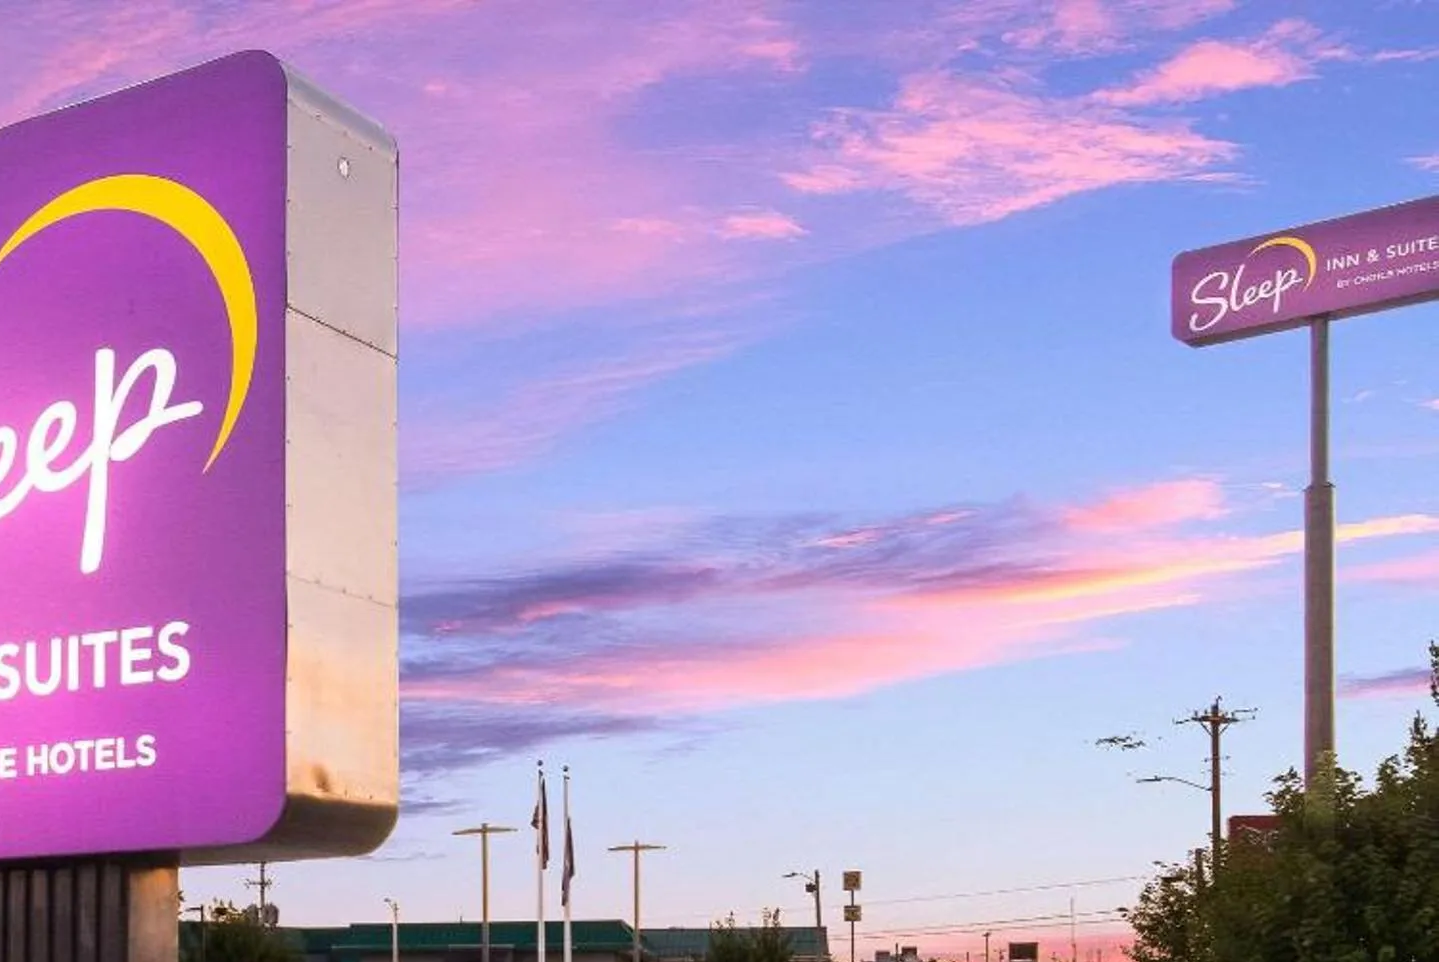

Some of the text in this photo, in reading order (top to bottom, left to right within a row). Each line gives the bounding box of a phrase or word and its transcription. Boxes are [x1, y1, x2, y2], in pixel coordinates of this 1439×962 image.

[1326, 253, 1360, 271] INN
[1366, 249, 1380, 263] &
[1189, 264, 1303, 332] Sleep
[27, 734, 157, 776] HOTELS
